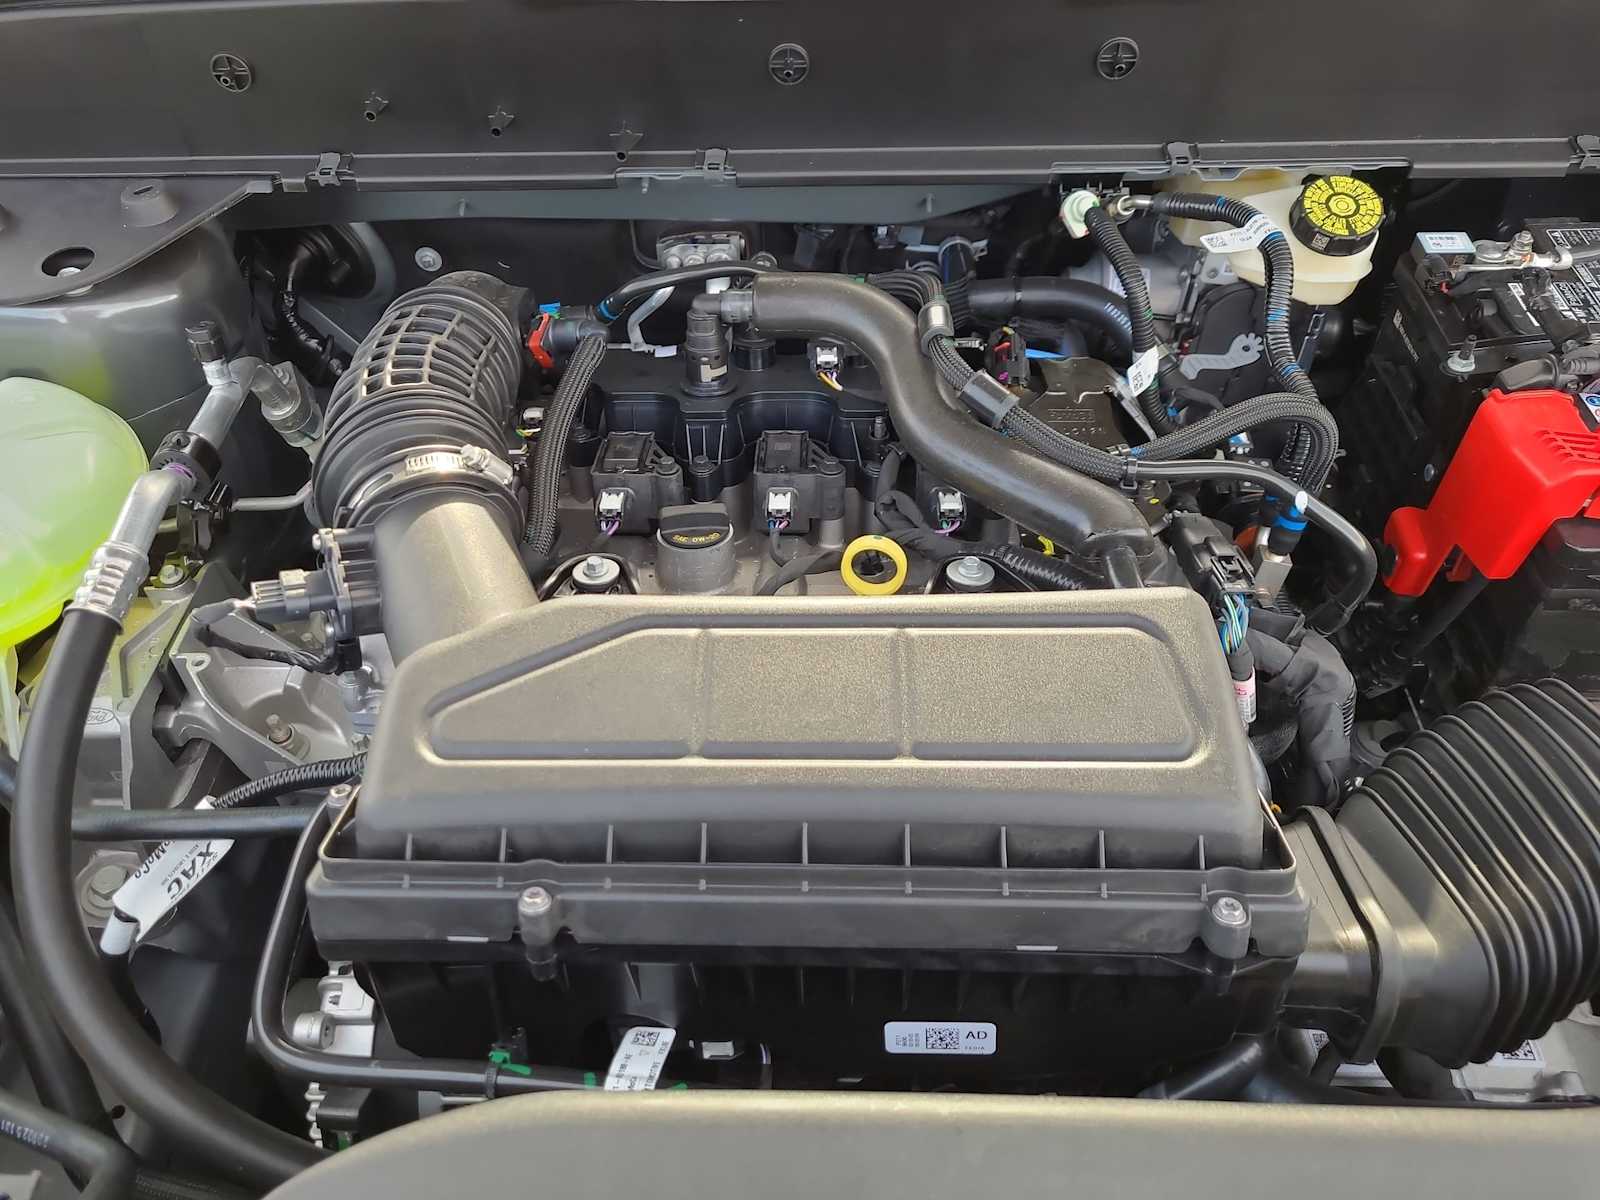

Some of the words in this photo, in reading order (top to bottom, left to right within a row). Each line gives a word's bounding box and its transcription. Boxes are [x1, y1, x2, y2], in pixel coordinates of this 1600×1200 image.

[134, 840, 175, 879] oMoCo
[167, 842, 214, 900] XAC
[966, 1031, 987, 1039] AD
